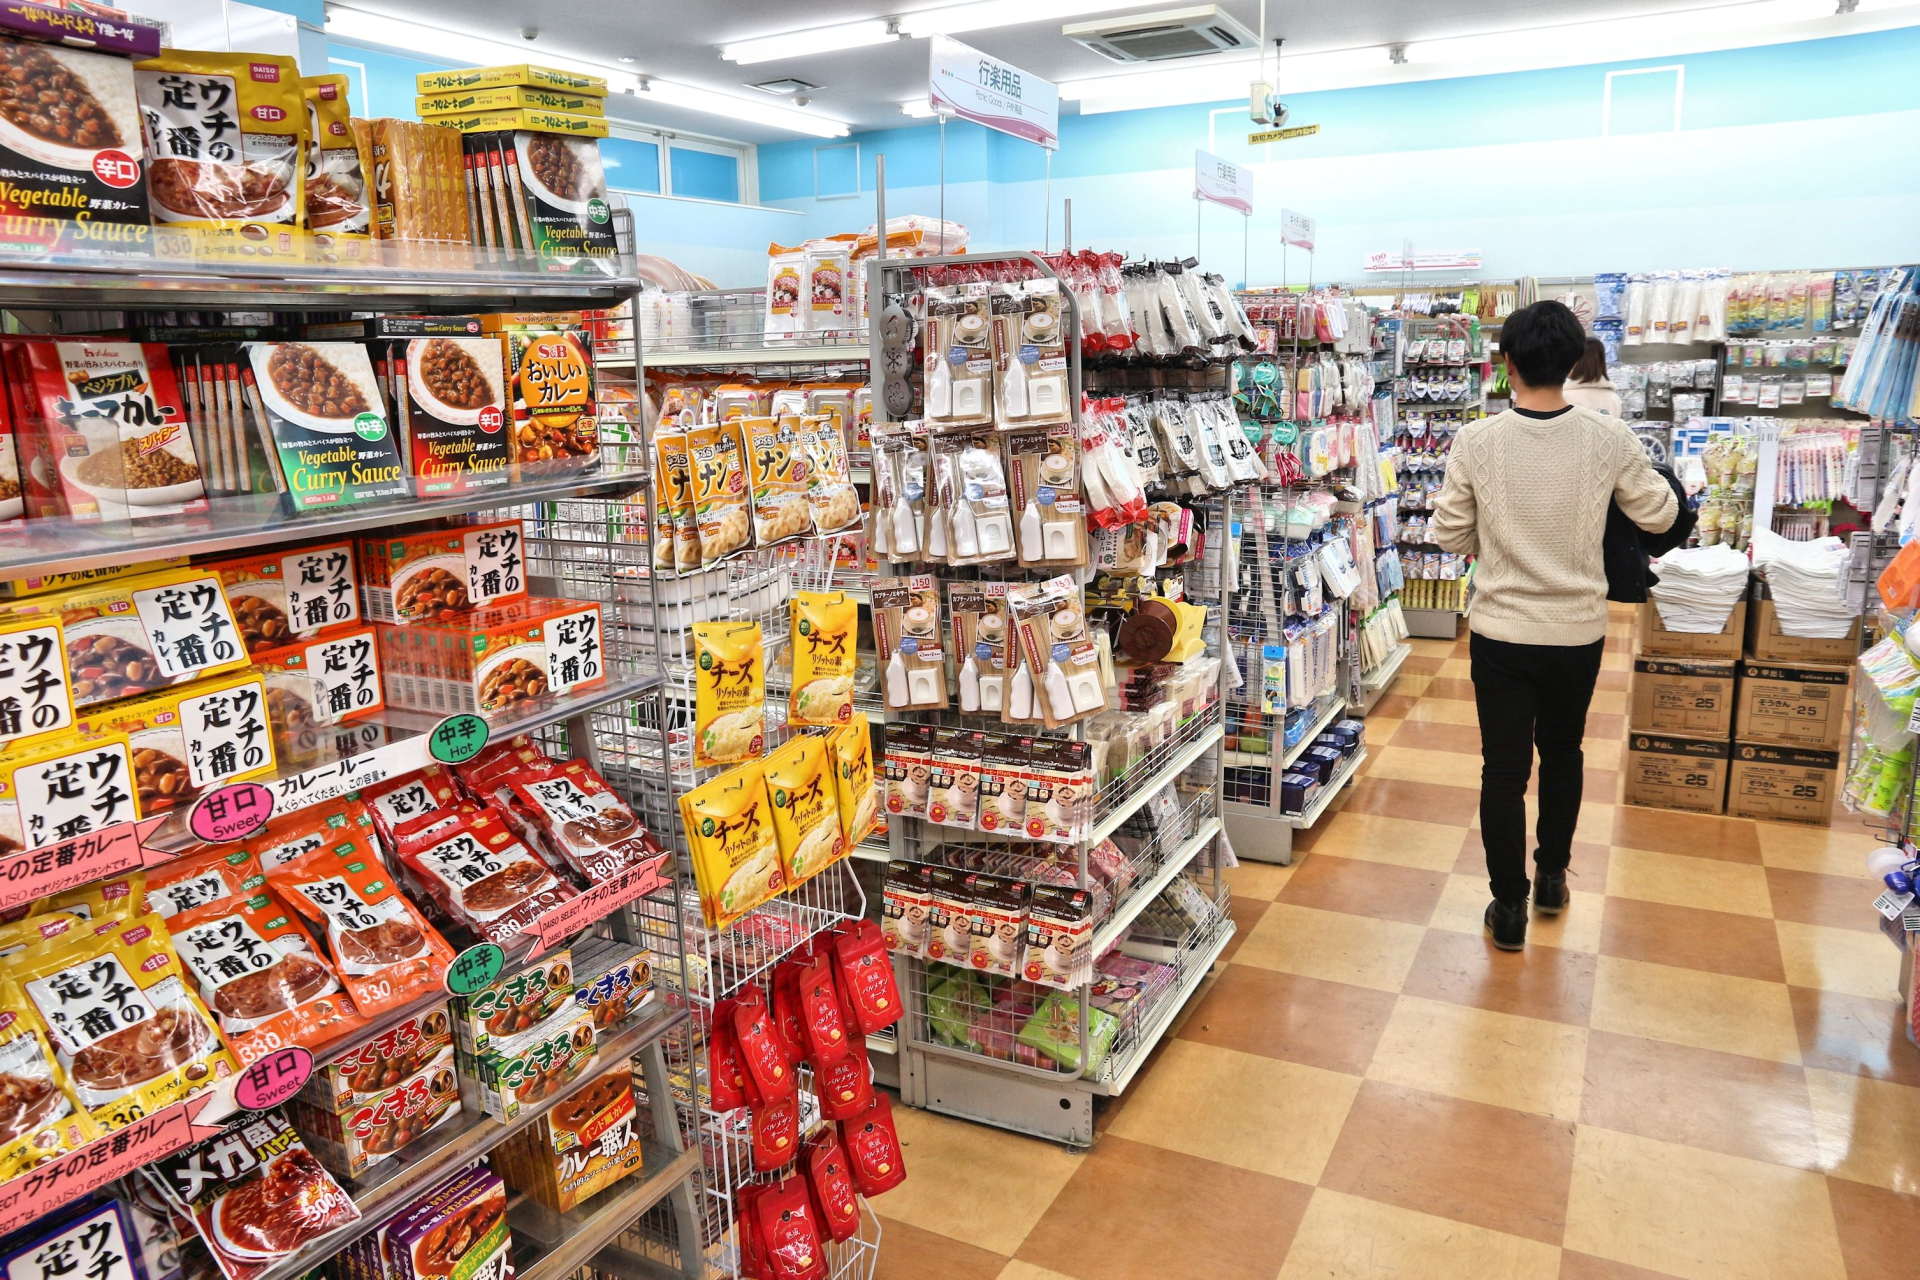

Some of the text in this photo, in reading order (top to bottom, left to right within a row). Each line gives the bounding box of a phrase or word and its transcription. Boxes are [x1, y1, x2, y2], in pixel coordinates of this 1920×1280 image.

[253, 66, 276, 75] DAISO
[979, 59, 1022, 100] 行楽用品
[159, 75, 200, 159] 定番
[255, 107, 281, 120] 甘口
[988, 94, 1003, 109] Goods
[200, 78, 237, 162] ウチの
[96, 159, 135, 180] 辛口
[0, 182, 139, 210] Vegetable 野菜カレー
[588, 205, 607, 218] 中辛
[545, 226, 588, 242] Vegetable
[541, 241, 580, 260] Curry
[1371, 253, 1387, 263] 100
[538, 345, 568, 358] S&B
[83, 374, 138, 394] ベジタブル
[526, 359, 583, 382] おいしい
[539, 381, 582, 404] カレー
[357, 419, 383, 435] 中辛
[480, 414, 501, 427] 辛口
[140, 425, 180, 453] スパイシー
[429, 438, 475, 458] Vegetable
[1011, 436, 1046, 444] カプチーノミキサー
[298, 446, 357, 469] Vegetable
[420, 457, 464, 483] Curry
[468, 454, 506, 475] Sauce
[757, 450, 792, 482] ナン
[293, 468, 347, 494] Curry
[352, 462, 401, 486] Sauce
[699, 462, 729, 497] ナン
[476, 533, 501, 596] 定番
[500, 530, 521, 591] ウチの
[298, 556, 329, 625] 定番
[326, 552, 352, 620] ウチの
[469, 565, 478, 598] カレー
[873, 590, 908, 600] カプチーノミキサー
[912, 577, 930, 588] ¥150
[988, 585, 1005, 595] ¥150
[110, 602, 129, 612] 甘口
[190, 584, 234, 660] ウチの
[289, 591, 301, 628] カレー
[155, 590, 207, 668] 定番
[808, 629, 848, 655] チーズ
[152, 630, 173, 672] カレー
[556, 619, 579, 683] 定番
[577, 614, 599, 677] ウチの
[812, 654, 842, 667] リゾットの素
[16, 635, 61, 728] ウチの
[323, 645, 352, 713] 定番
[349, 640, 375, 706] ウチの
[549, 652, 558, 687] カレー
[710, 658, 754, 689] チーズ
[716, 685, 750, 700] リゾットの素
[156, 712, 175, 724] 甘口
[231, 689, 265, 766] ウチの
[438, 717, 477, 747] 中辛
[199, 697, 237, 777] 定番
[450, 742, 474, 759] Hot
[189, 739, 204, 782] カレー
[279, 756, 376, 797] カレールー
[1030, 774, 1063, 783] コーヒードリッパー
[203, 787, 257, 823] 甘口
[552, 780, 596, 813] ウチの
[786, 773, 823, 821] チーズ
[213, 812, 262, 838] Sweet
[714, 802, 761, 851] チーズ
[794, 801, 823, 826] リゾットの素
[453, 837, 502, 871] ウチの
[724, 831, 759, 859] リゾットの素
[30, 858, 132, 897] のオリジナルブランドです。
[432, 845, 485, 882] 定番
[586, 857, 615, 880] 280
[366, 882, 384, 893] 中辛
[543, 866, 654, 932] DAISO SELECT ウチの定番カレー
[325, 882, 377, 925] ウチの
[124, 928, 146, 939] DAISO
[268, 916, 288, 929] 中辛
[490, 919, 521, 943] 280
[187, 930, 249, 978] 定番
[219, 921, 272, 967] ウチの
[144, 954, 169, 971] 甘口
[456, 948, 493, 979] 中辛
[88, 961, 146, 1023] ウチの
[357, 980, 391, 1005] 330
[467, 970, 490, 990] Hot
[471, 967, 548, 1019] こくまろ
[574, 965, 632, 1006] こくまろ
[862, 978, 889, 995] パルメザン
[870, 988, 887, 1000] チーズ
[48, 972, 118, 1040] 定番
[524, 991, 543, 1004] カレー
[51, 1012, 79, 1047] カレー
[240, 1032, 281, 1062] 330
[332, 1018, 421, 1075] こくまろ
[501, 1032, 572, 1089] こくまろ
[551, 1055, 569, 1069] カレー
[247, 1051, 297, 1091] 甘口
[827, 1071, 860, 1086] パルメザン
[835, 1079, 856, 1092] チーズ
[256, 1076, 301, 1106] Sweet
[346, 1078, 429, 1138] こくまろ
[585, 1100, 629, 1142] インド風カレー
[763, 1116, 793, 1133] パルメザン
[770, 1127, 789, 1138] チーズ
[23, 1112, 183, 1197] ウチの定番カレー
[558, 1120, 639, 1185] カレー職人
[863, 1143, 890, 1161] パルメザン
[871, 1153, 889, 1165] チーズ
[561, 1146, 638, 1194] 本格的なソースが楽しめる
[201, 1175, 255, 1206] MEGA
[307, 1189, 341, 1221] 300g
[420, 1183, 486, 1232] カレー職人 なすとトマトのカレー
[454, 1229, 503, 1280] なすとトマトのカレー
